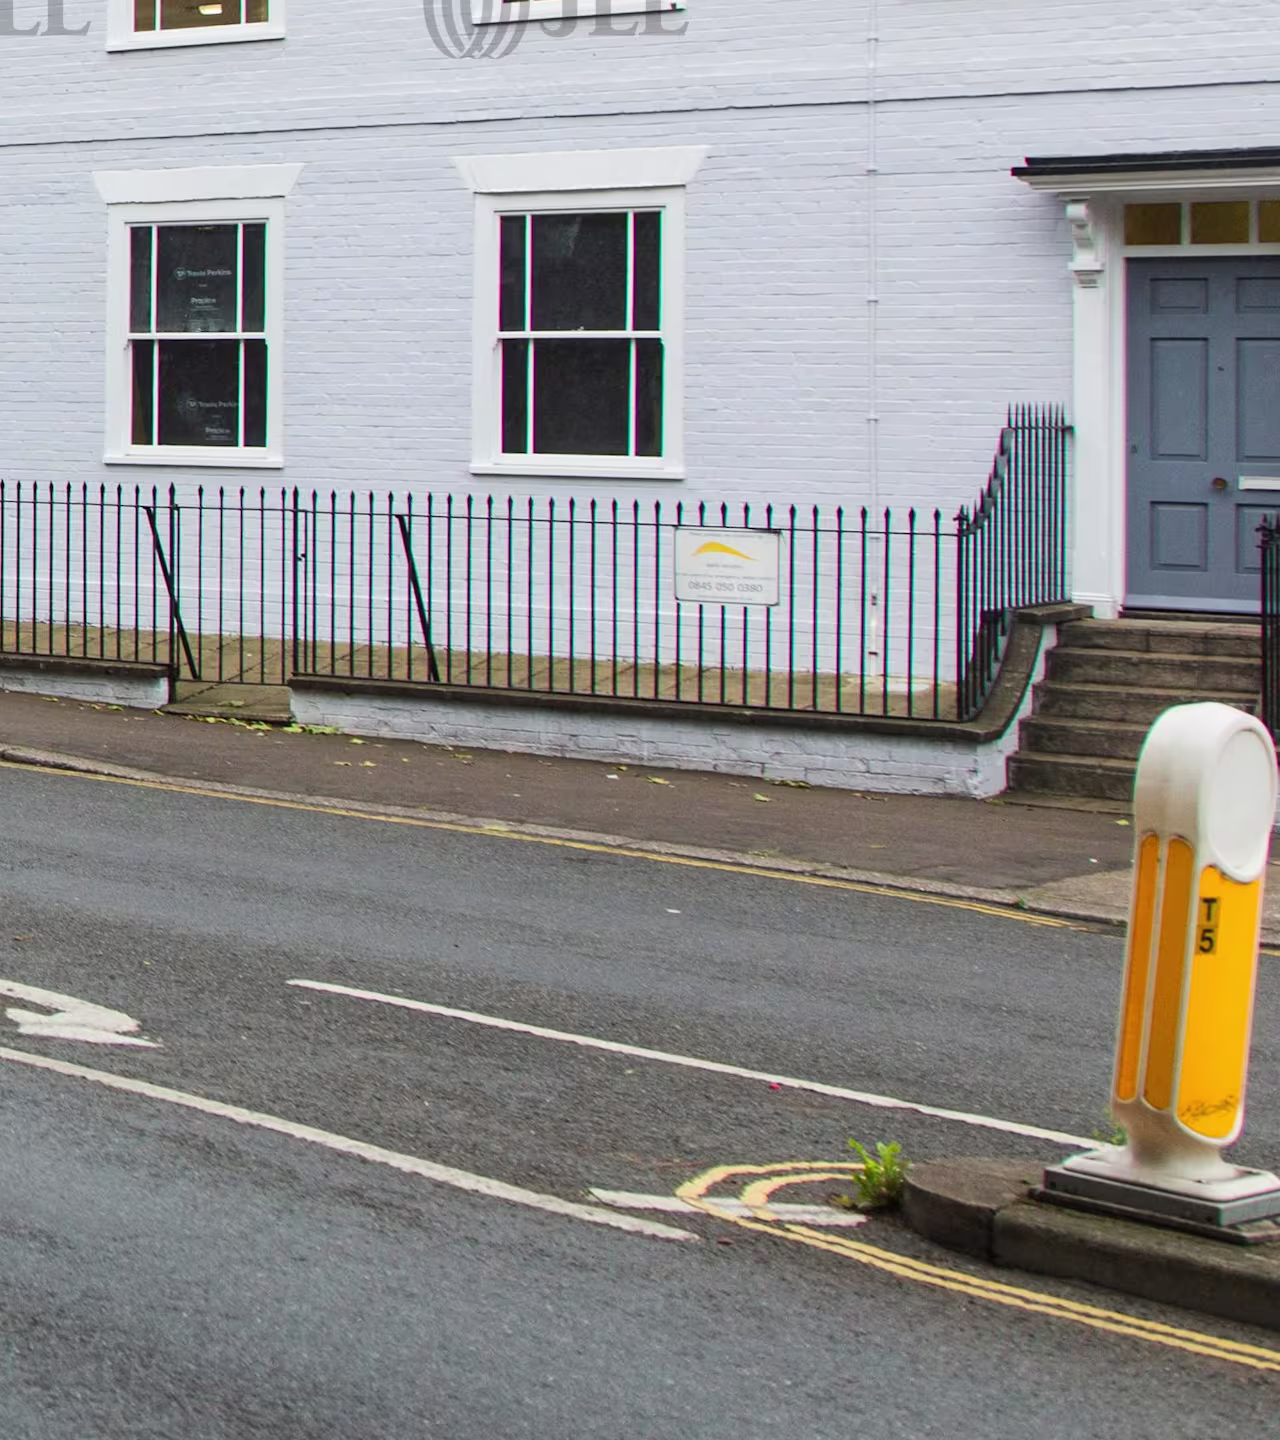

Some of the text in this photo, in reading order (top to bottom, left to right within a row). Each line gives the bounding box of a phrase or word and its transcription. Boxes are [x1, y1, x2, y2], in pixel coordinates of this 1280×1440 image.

[688, 581, 763, 593] 0845 050 0380
